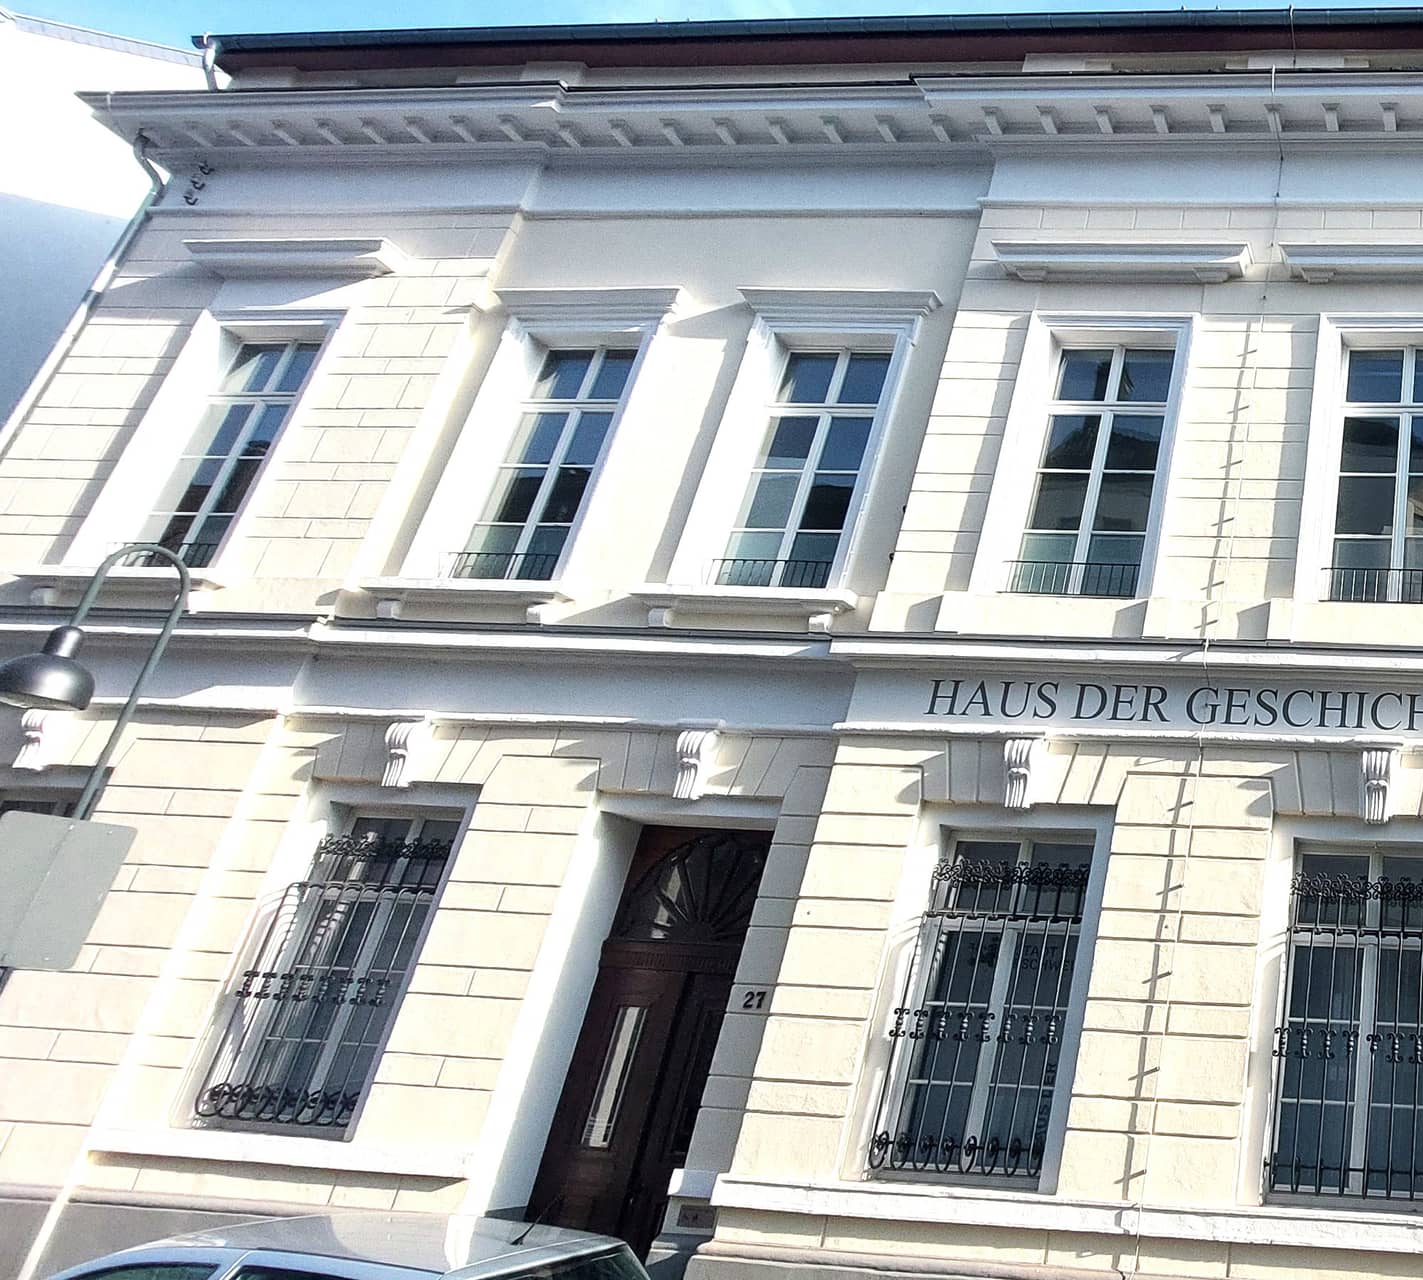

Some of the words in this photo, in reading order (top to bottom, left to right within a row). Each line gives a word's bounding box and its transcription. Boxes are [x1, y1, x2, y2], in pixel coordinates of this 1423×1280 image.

[924, 679, 1060, 719] HAUS
[1071, 683, 1171, 723] DER
[742, 991, 767, 1009] 27
